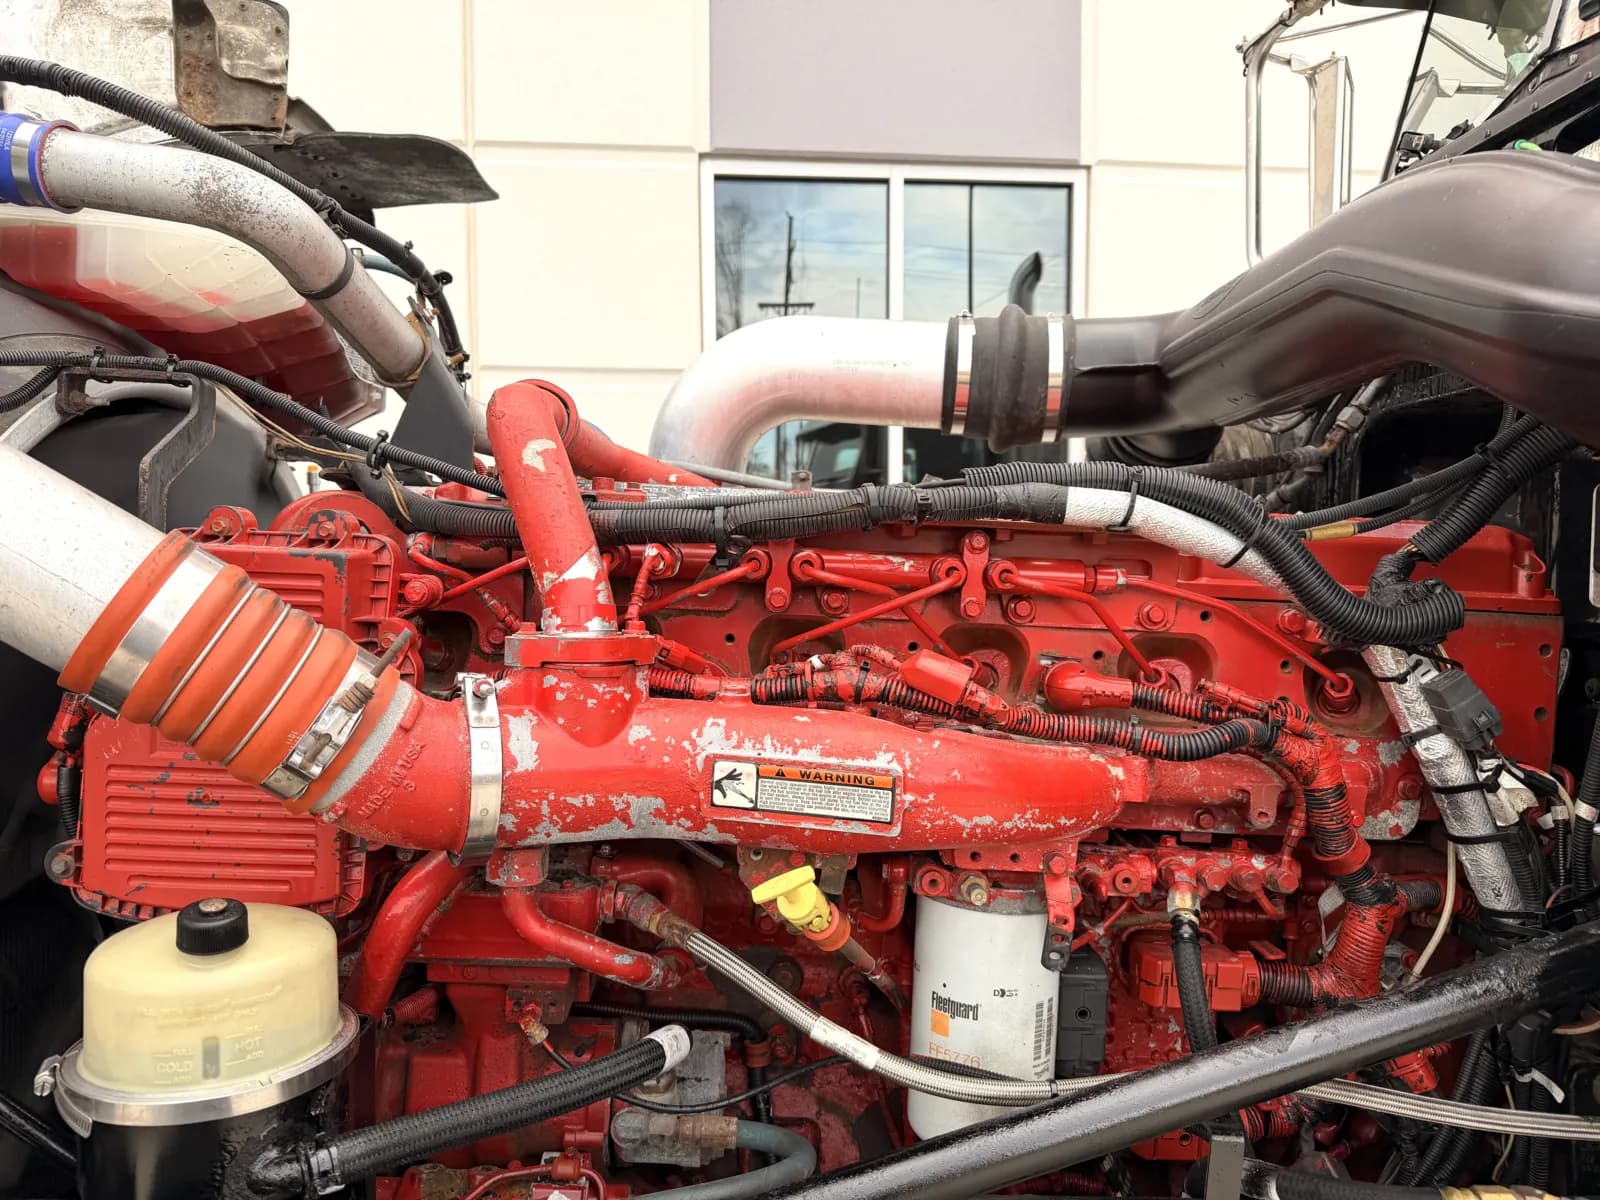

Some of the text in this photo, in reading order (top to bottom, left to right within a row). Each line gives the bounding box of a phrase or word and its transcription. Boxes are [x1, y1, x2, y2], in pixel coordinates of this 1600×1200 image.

[357, 743, 427, 818] MADE IN USA
[799, 769, 875, 786] WARNING
[931, 990, 979, 1021] Fleetguard
[234, 1036, 263, 1051] HOT
[156, 1060, 193, 1074] COLD
